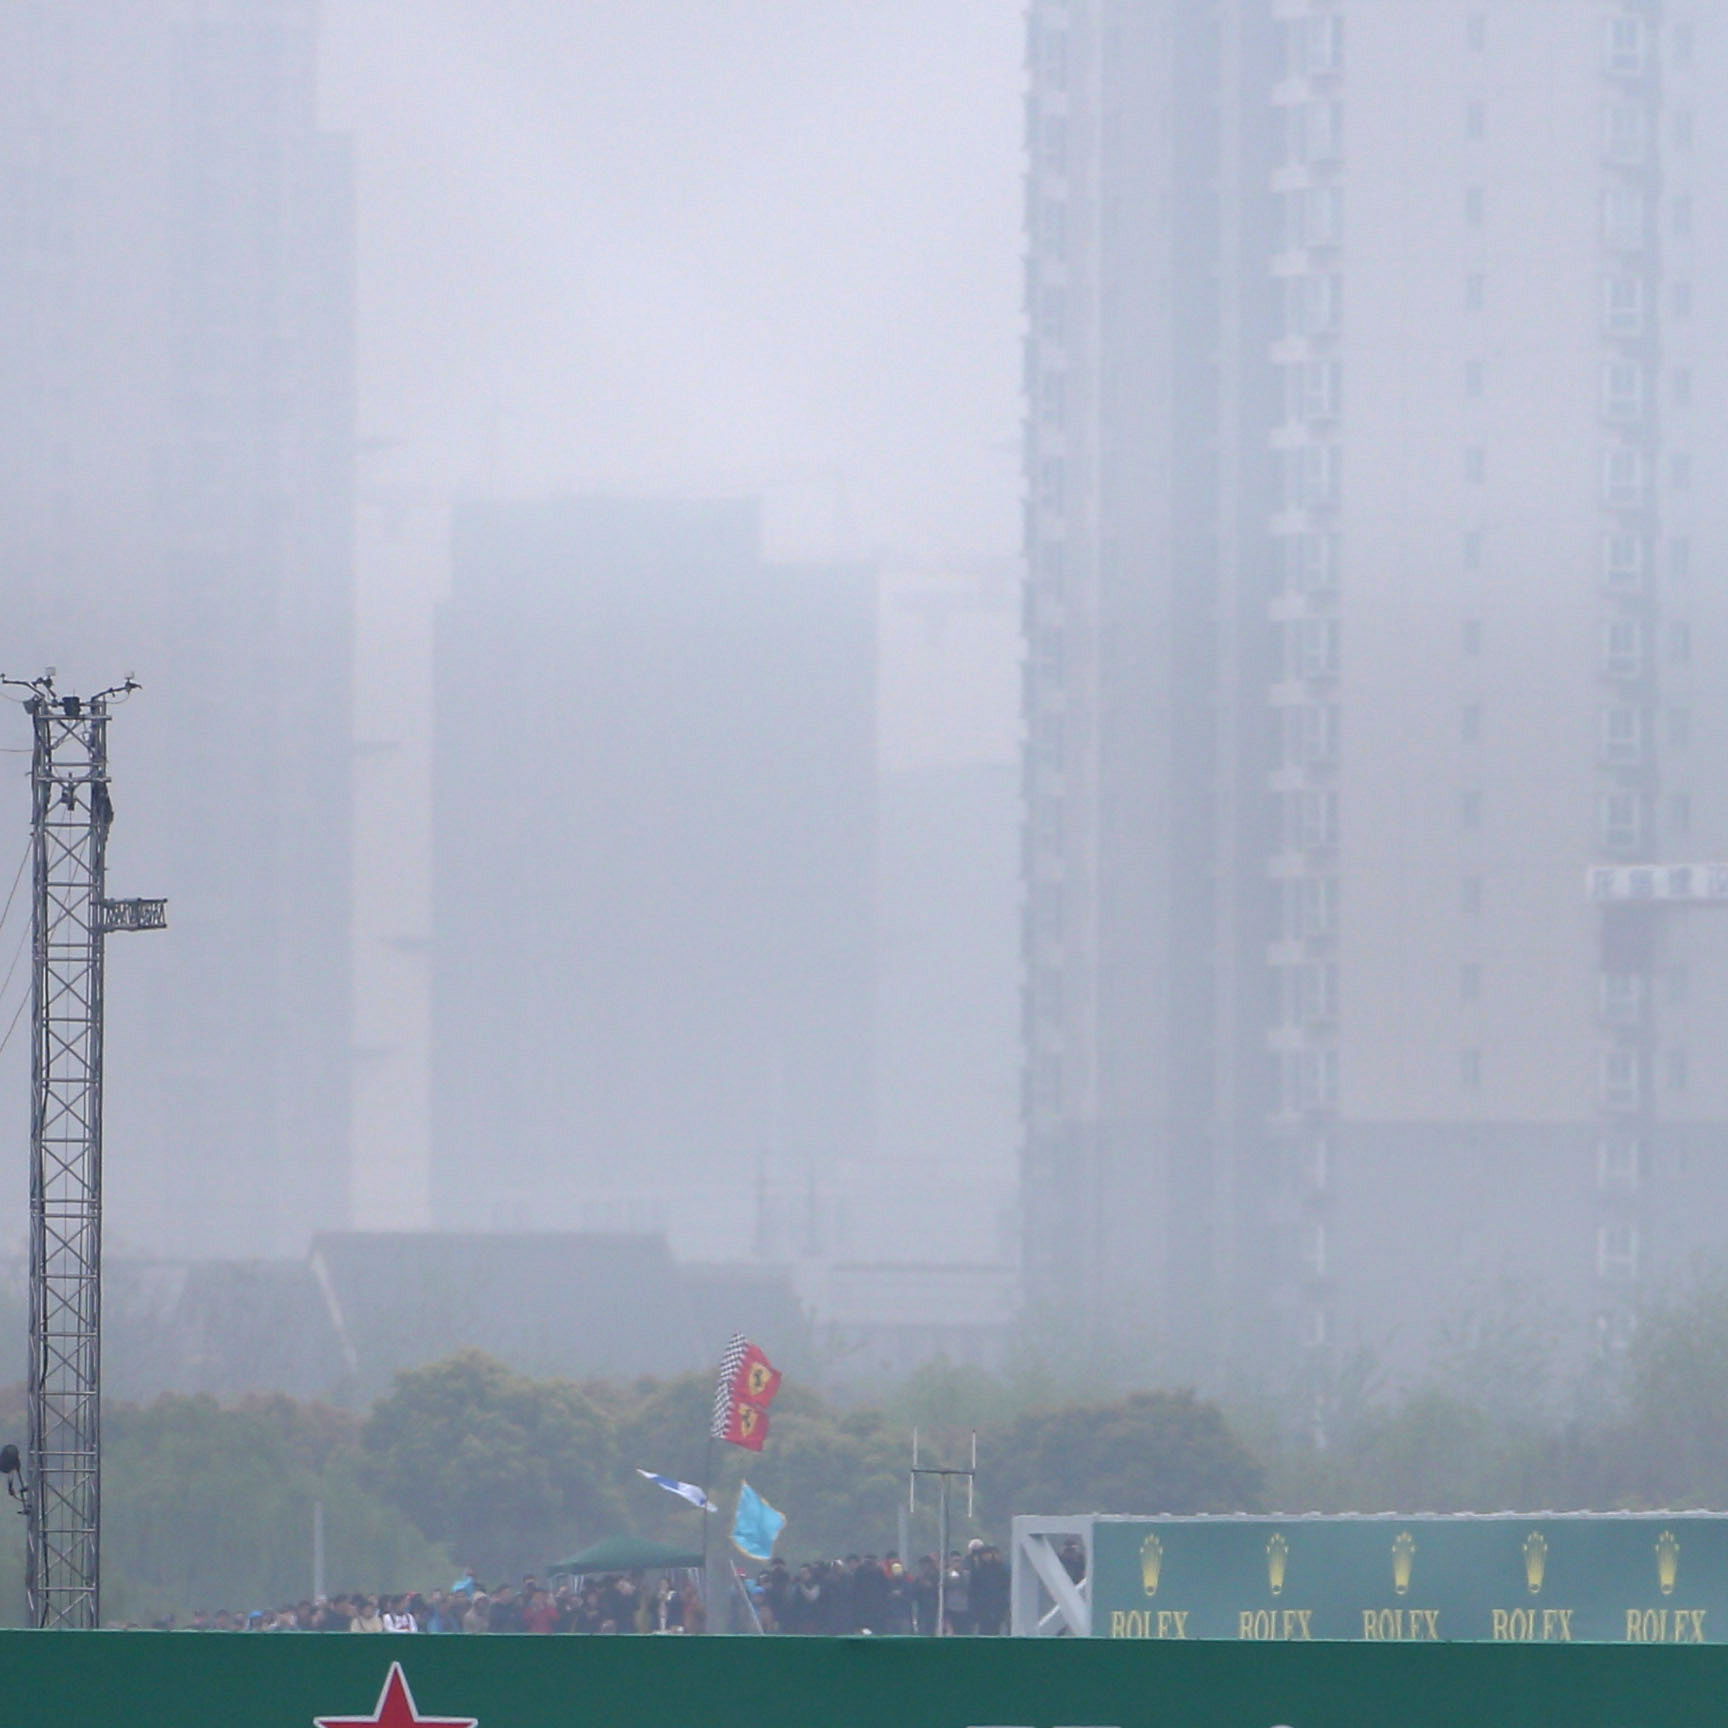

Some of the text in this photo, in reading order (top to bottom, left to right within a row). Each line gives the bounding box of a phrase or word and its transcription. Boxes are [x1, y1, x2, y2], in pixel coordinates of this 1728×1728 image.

[1111, 1610, 1189, 1638] ROLEX
[1239, 1610, 1313, 1640] ROLEX
[1362, 1609, 1440, 1640] ROLEX
[1492, 1609, 1574, 1641] ROLEX
[1626, 1609, 1706, 1642] ROLEX
